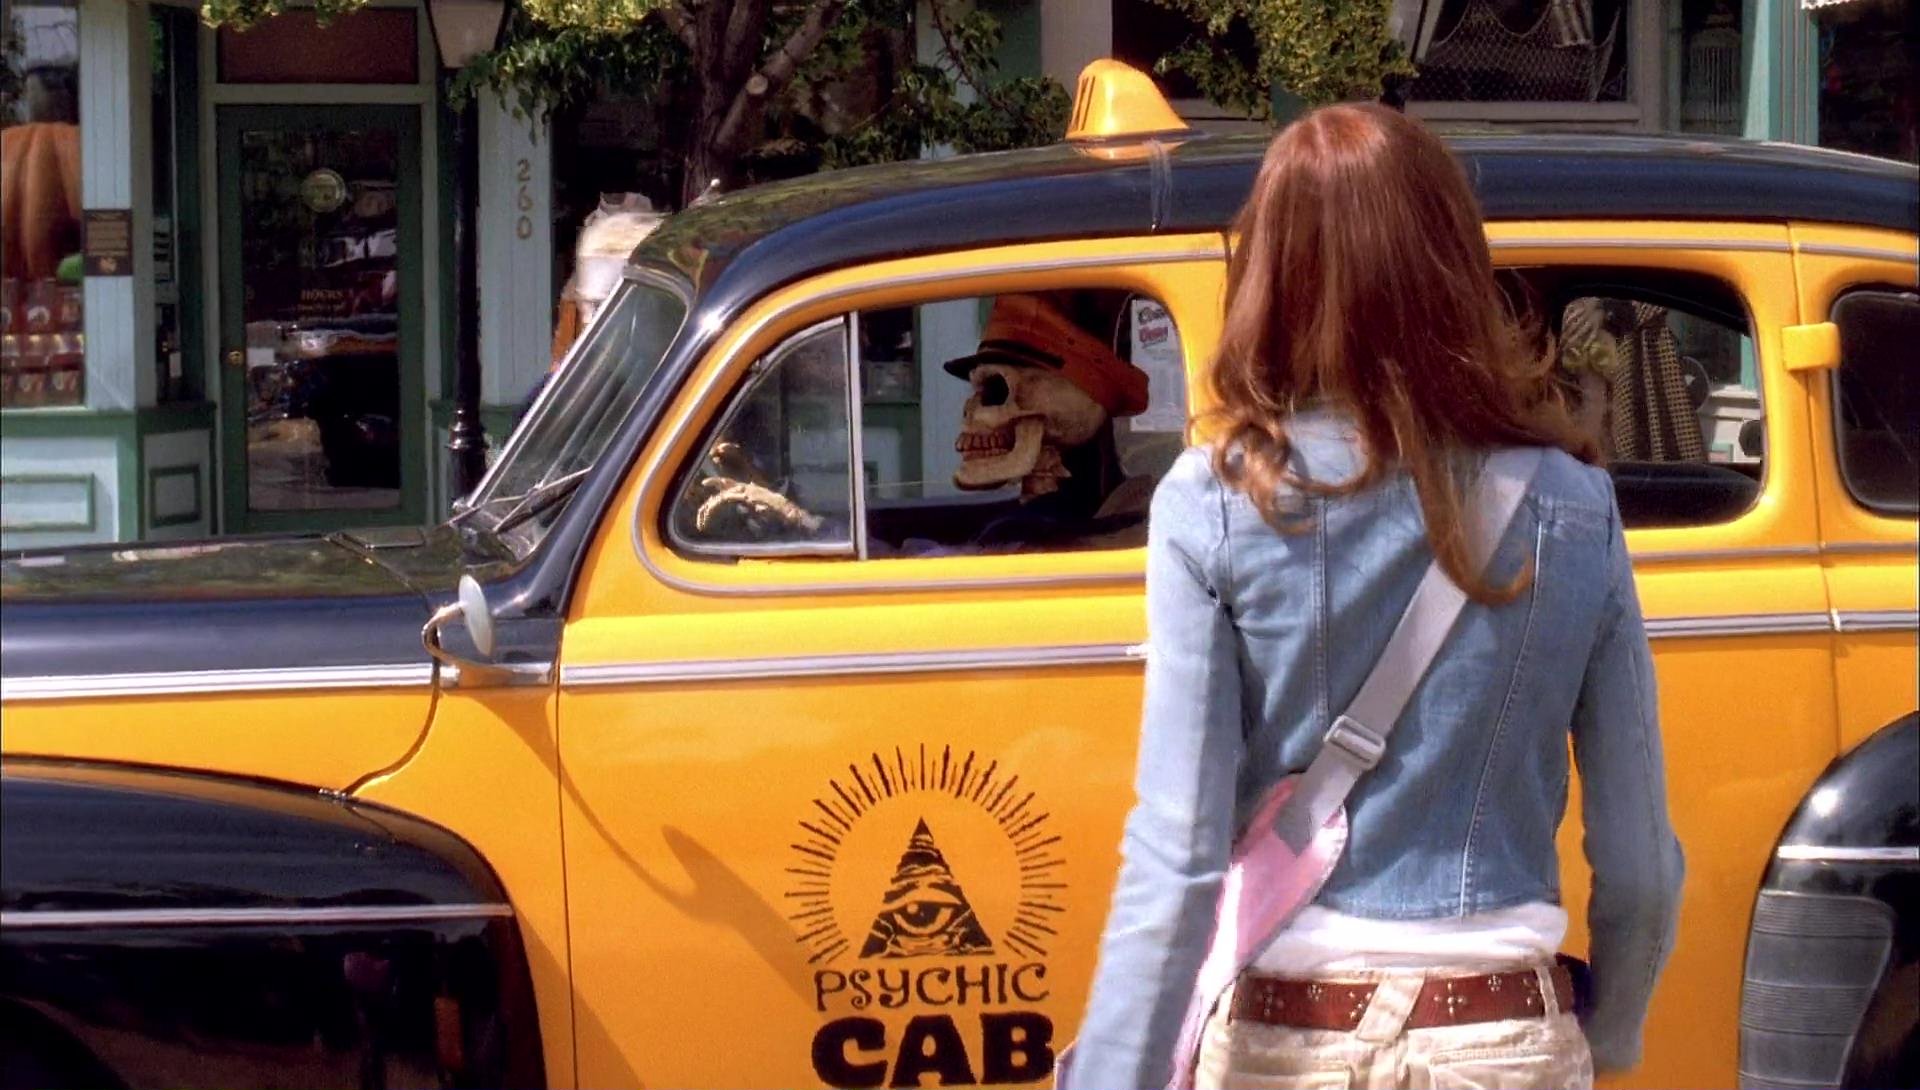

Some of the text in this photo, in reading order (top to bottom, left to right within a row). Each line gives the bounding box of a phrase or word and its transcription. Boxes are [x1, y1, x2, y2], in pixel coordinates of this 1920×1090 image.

[517, 158, 533, 240] 260
[814, 963, 1050, 1011] PSYCHIC
[811, 1010, 1055, 1089] CAB
